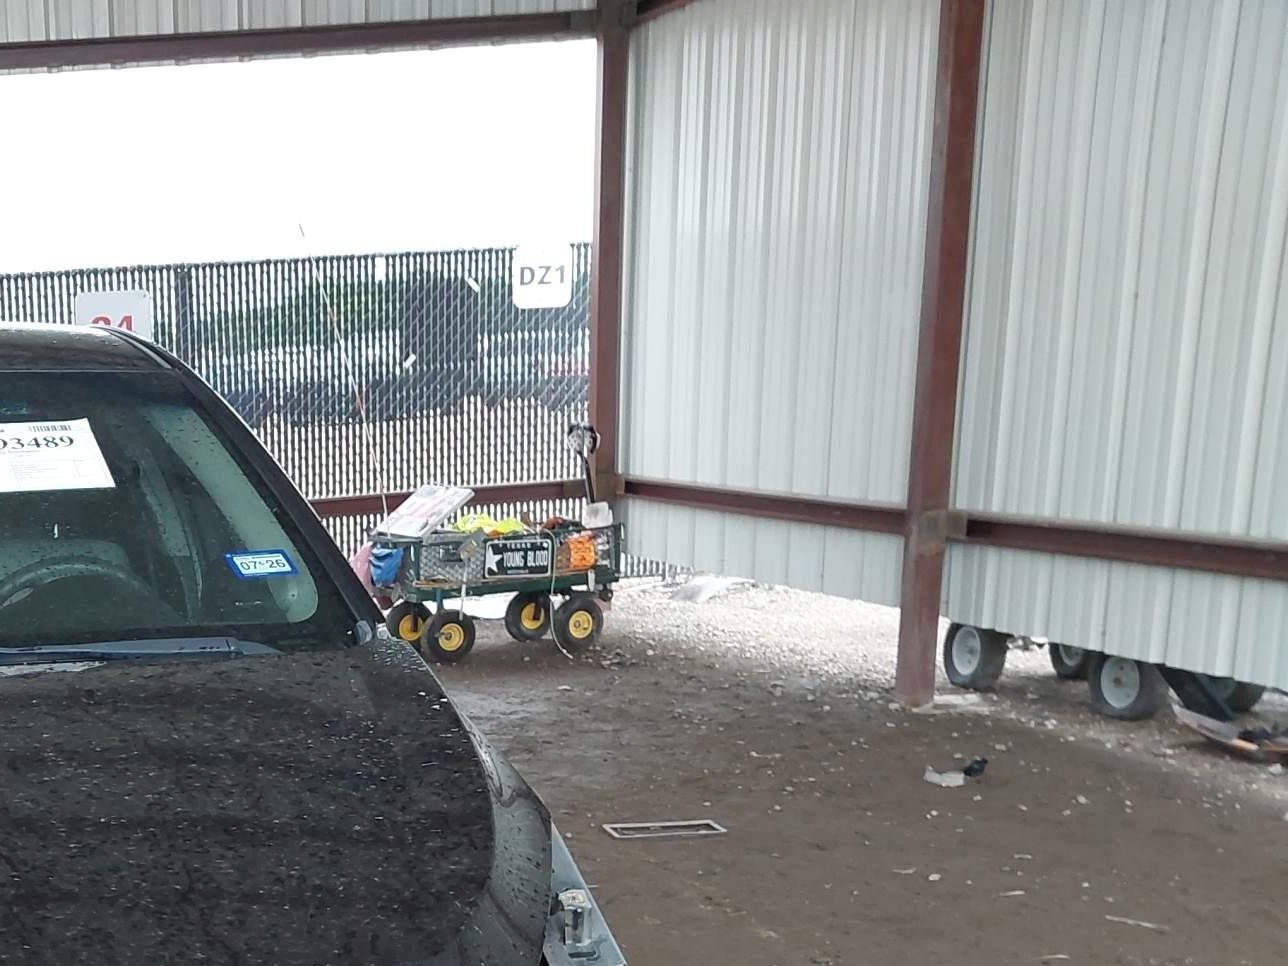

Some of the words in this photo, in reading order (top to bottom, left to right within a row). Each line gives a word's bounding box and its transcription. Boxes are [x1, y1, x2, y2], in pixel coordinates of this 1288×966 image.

[519, 264, 565, 286] DZ1
[502, 551, 525, 568] YOUNG
[526, 550, 548, 567] BLOOD
